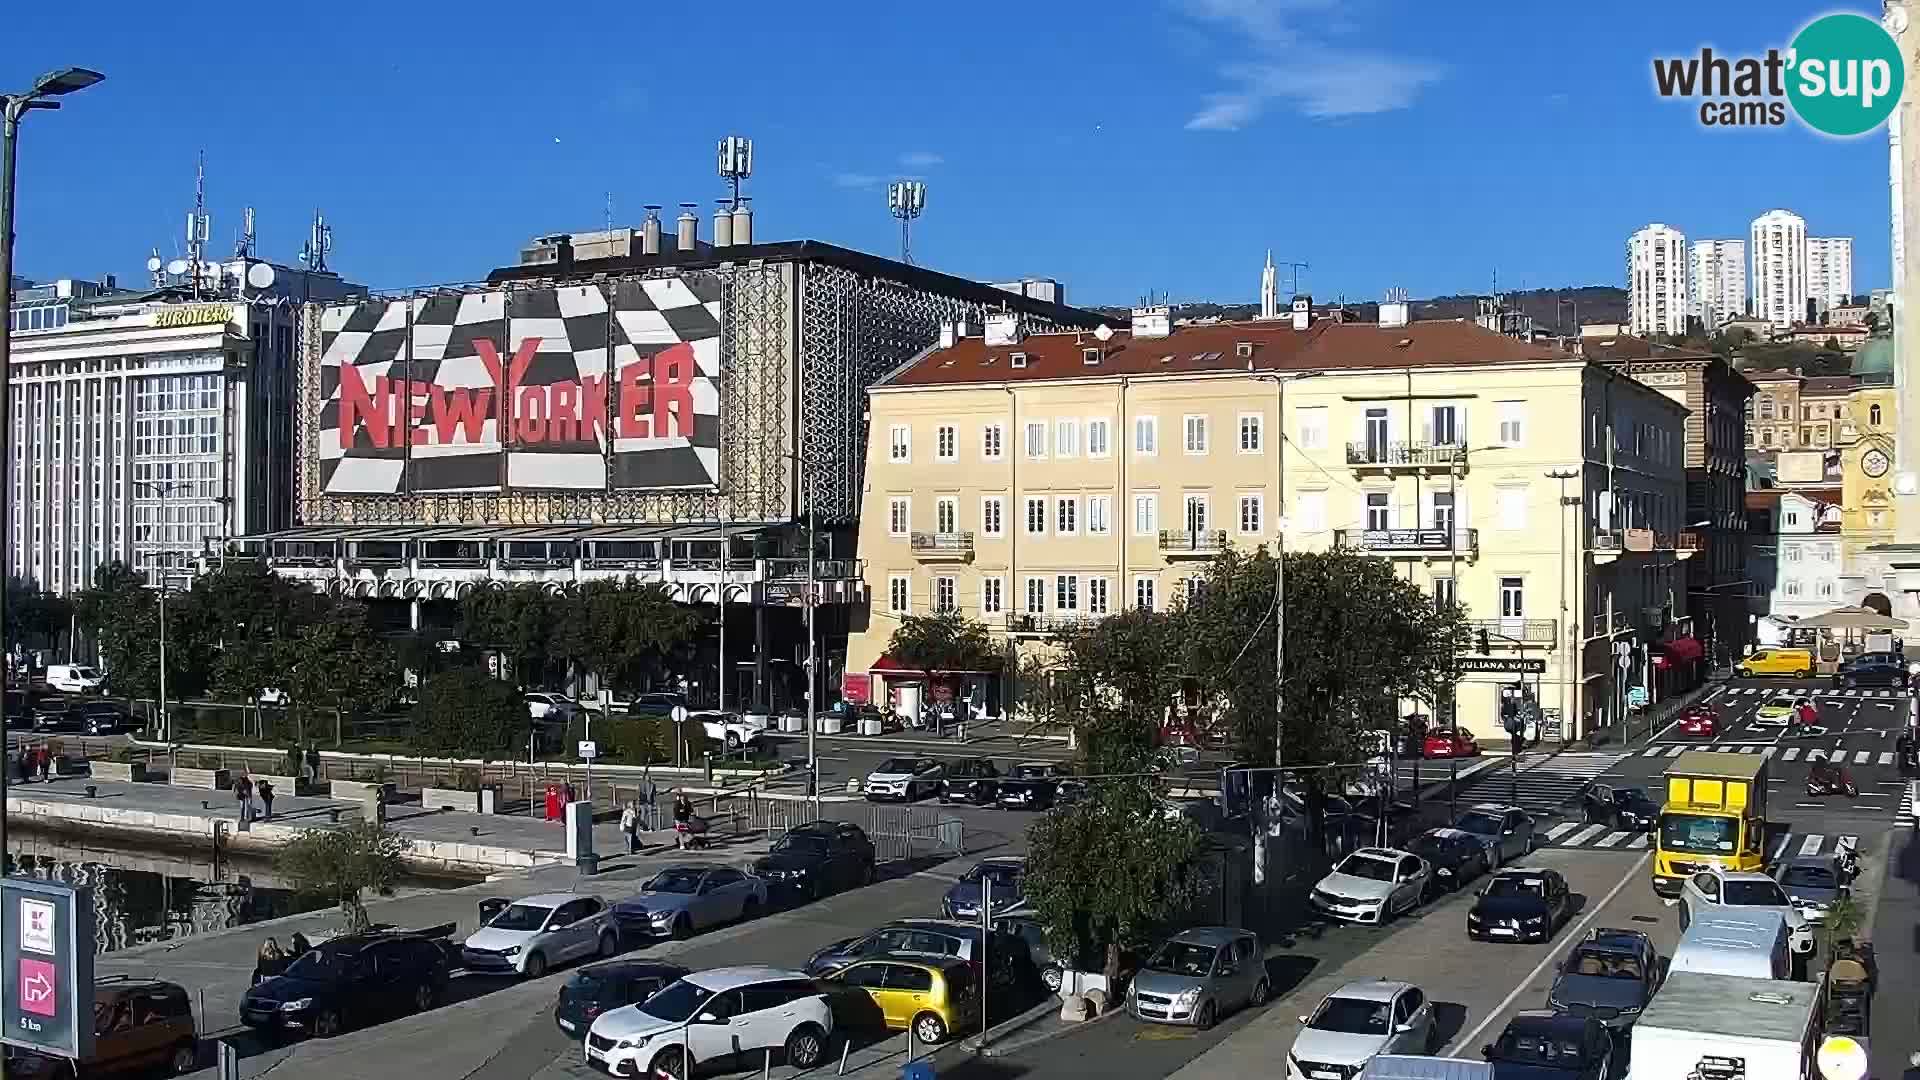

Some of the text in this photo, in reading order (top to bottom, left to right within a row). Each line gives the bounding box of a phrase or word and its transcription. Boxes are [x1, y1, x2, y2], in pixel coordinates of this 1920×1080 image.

[1460, 661, 1541, 670] JULIANA NAILS
[20, 1017, 27, 1029] 5
